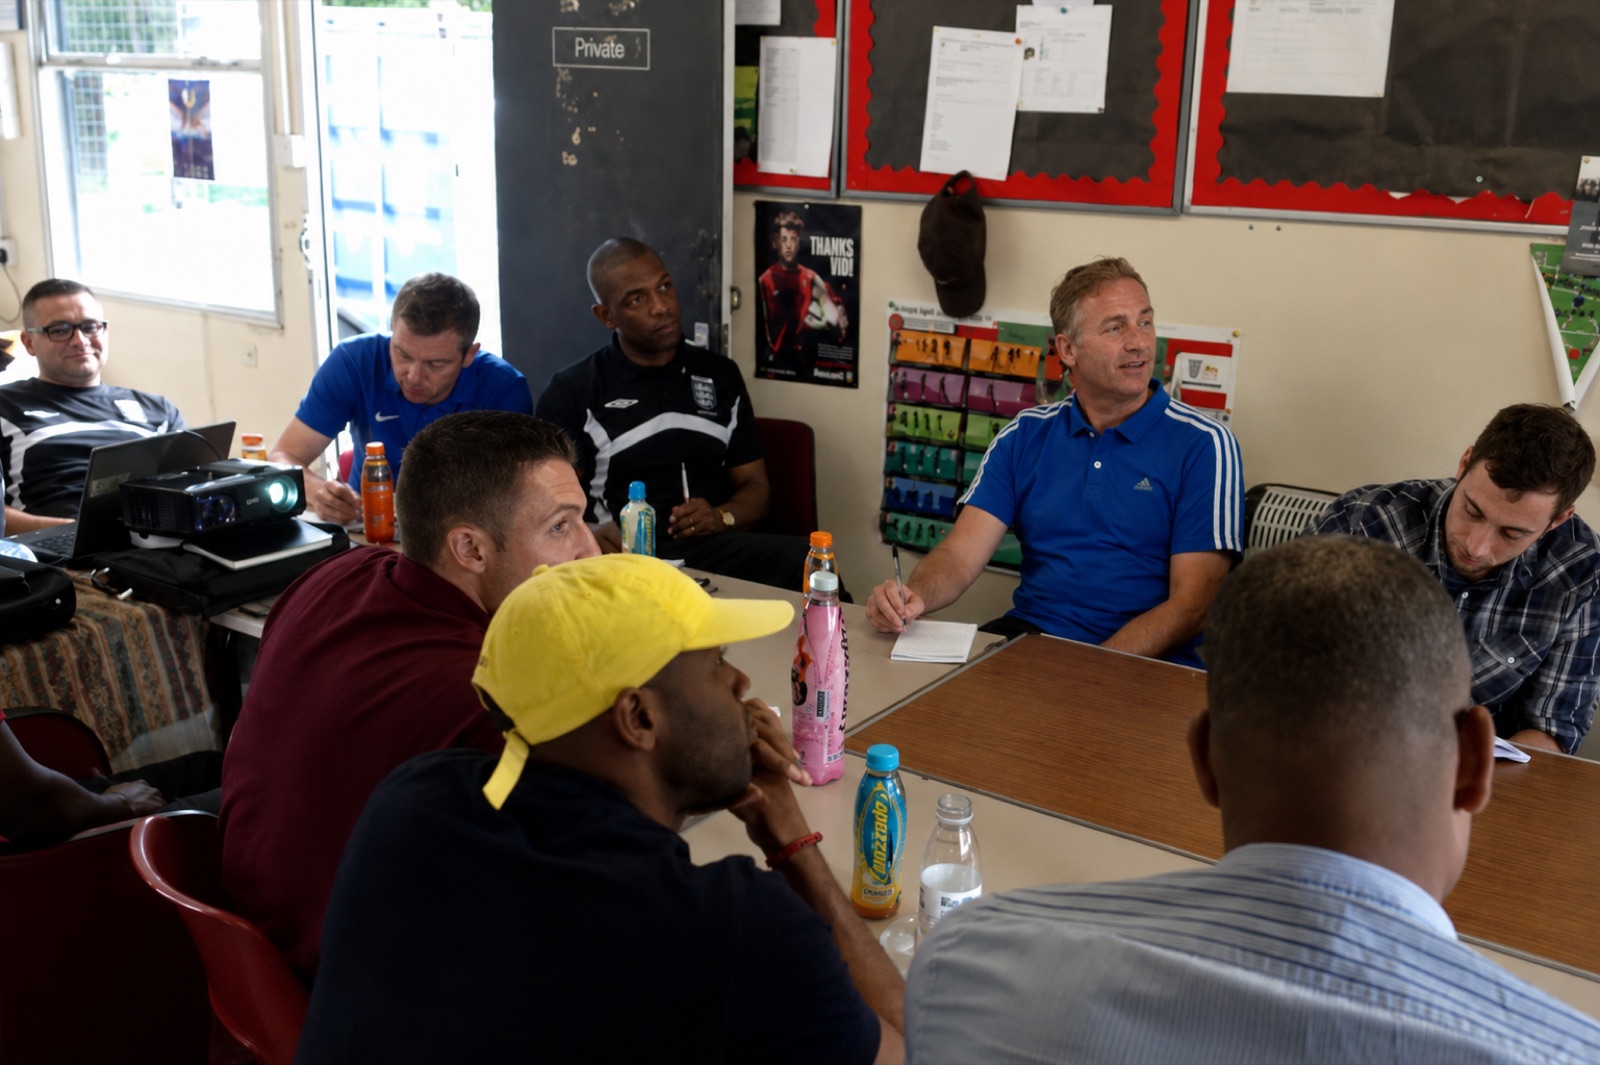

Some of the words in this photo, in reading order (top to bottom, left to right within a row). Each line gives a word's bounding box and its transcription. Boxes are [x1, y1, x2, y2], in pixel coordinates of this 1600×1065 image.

[575, 37, 625, 59] Private
[810, 235, 854, 257] THANKS
[830, 256, 854, 277] VID!
